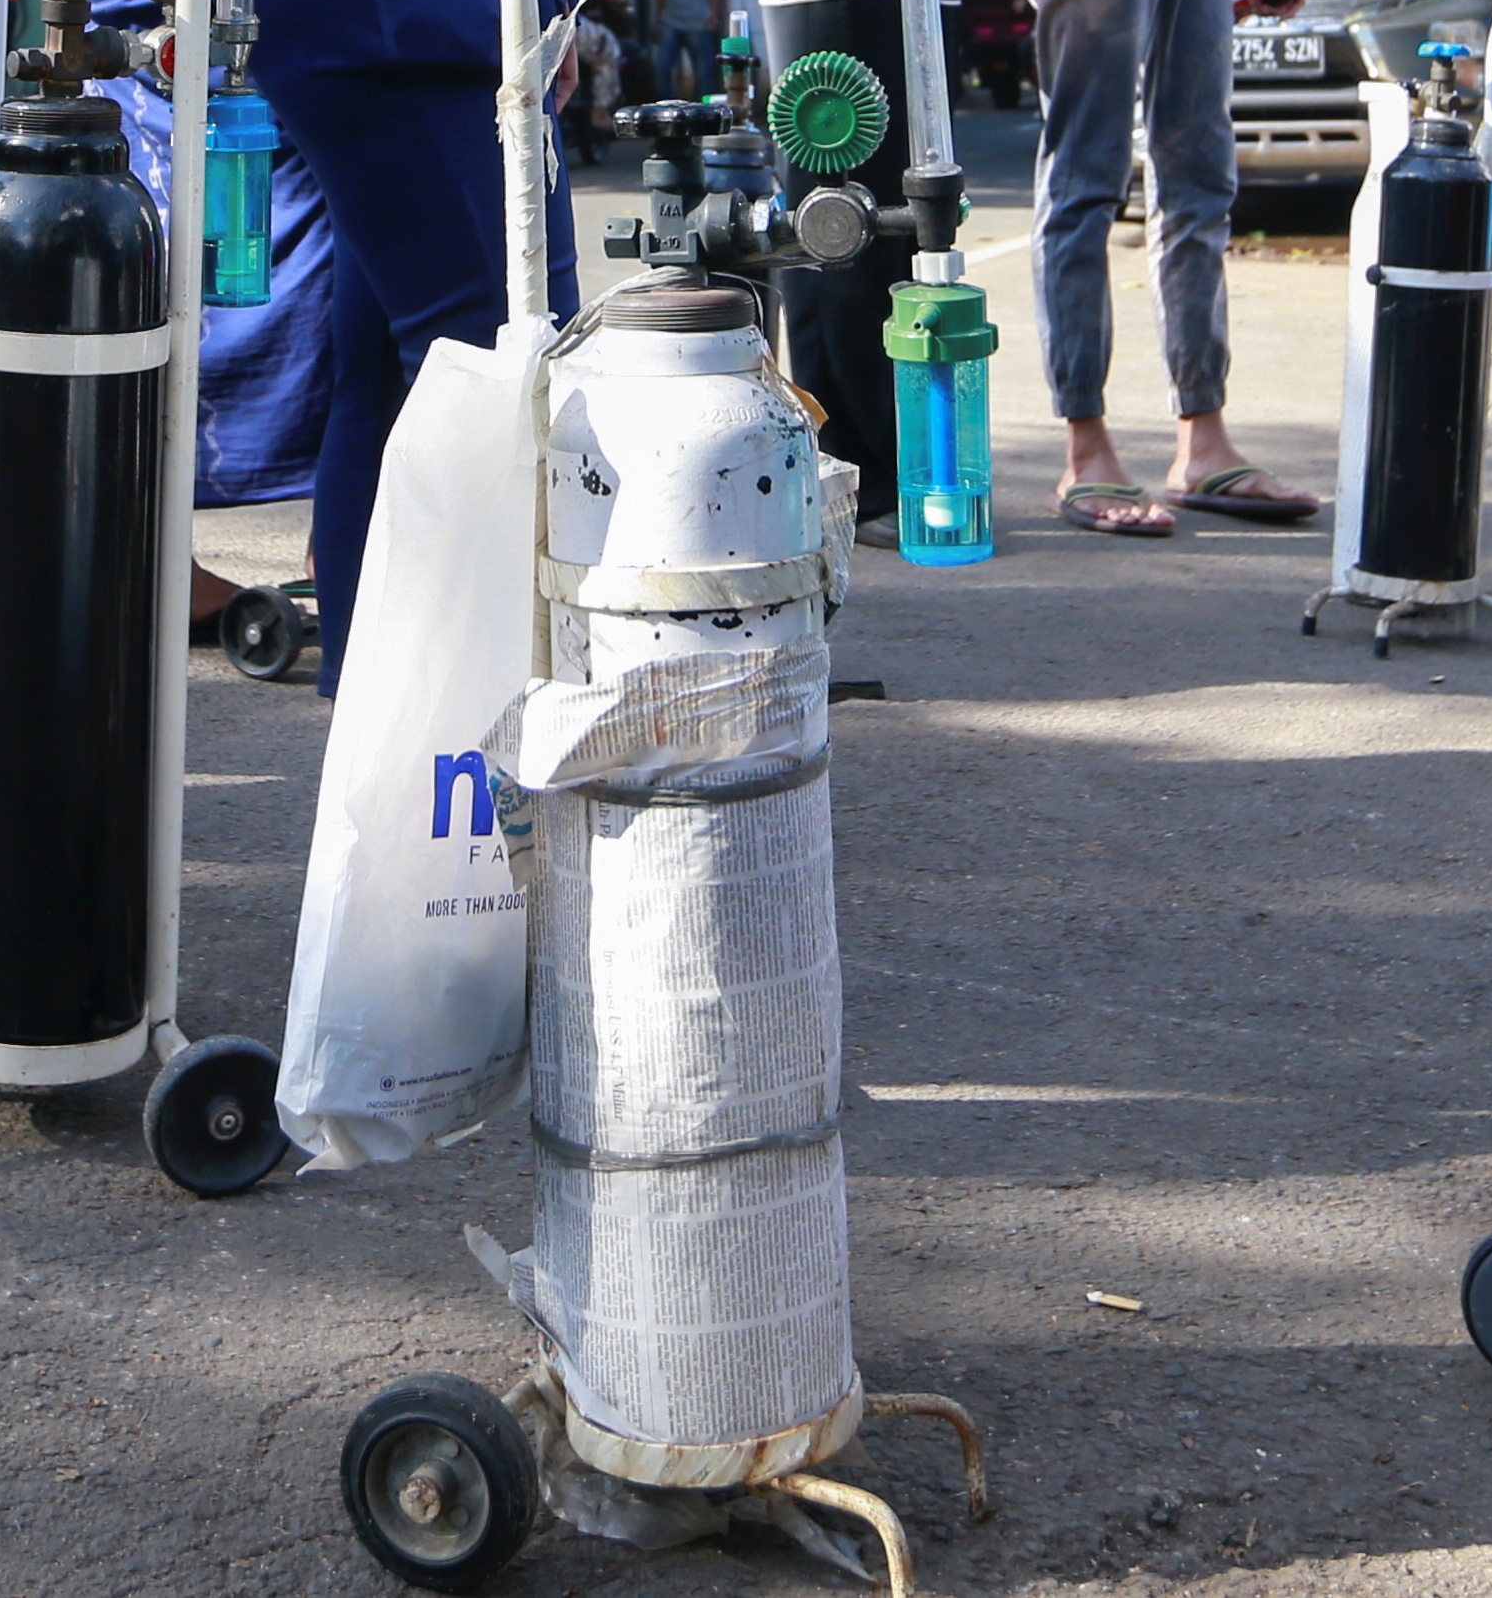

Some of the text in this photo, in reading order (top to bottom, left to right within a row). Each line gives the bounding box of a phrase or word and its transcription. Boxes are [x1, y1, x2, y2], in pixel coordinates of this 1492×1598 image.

[424, 898, 460, 919] MORE
[465, 895, 495, 916] THAN
[612, 1080, 626, 1123] Miliar
